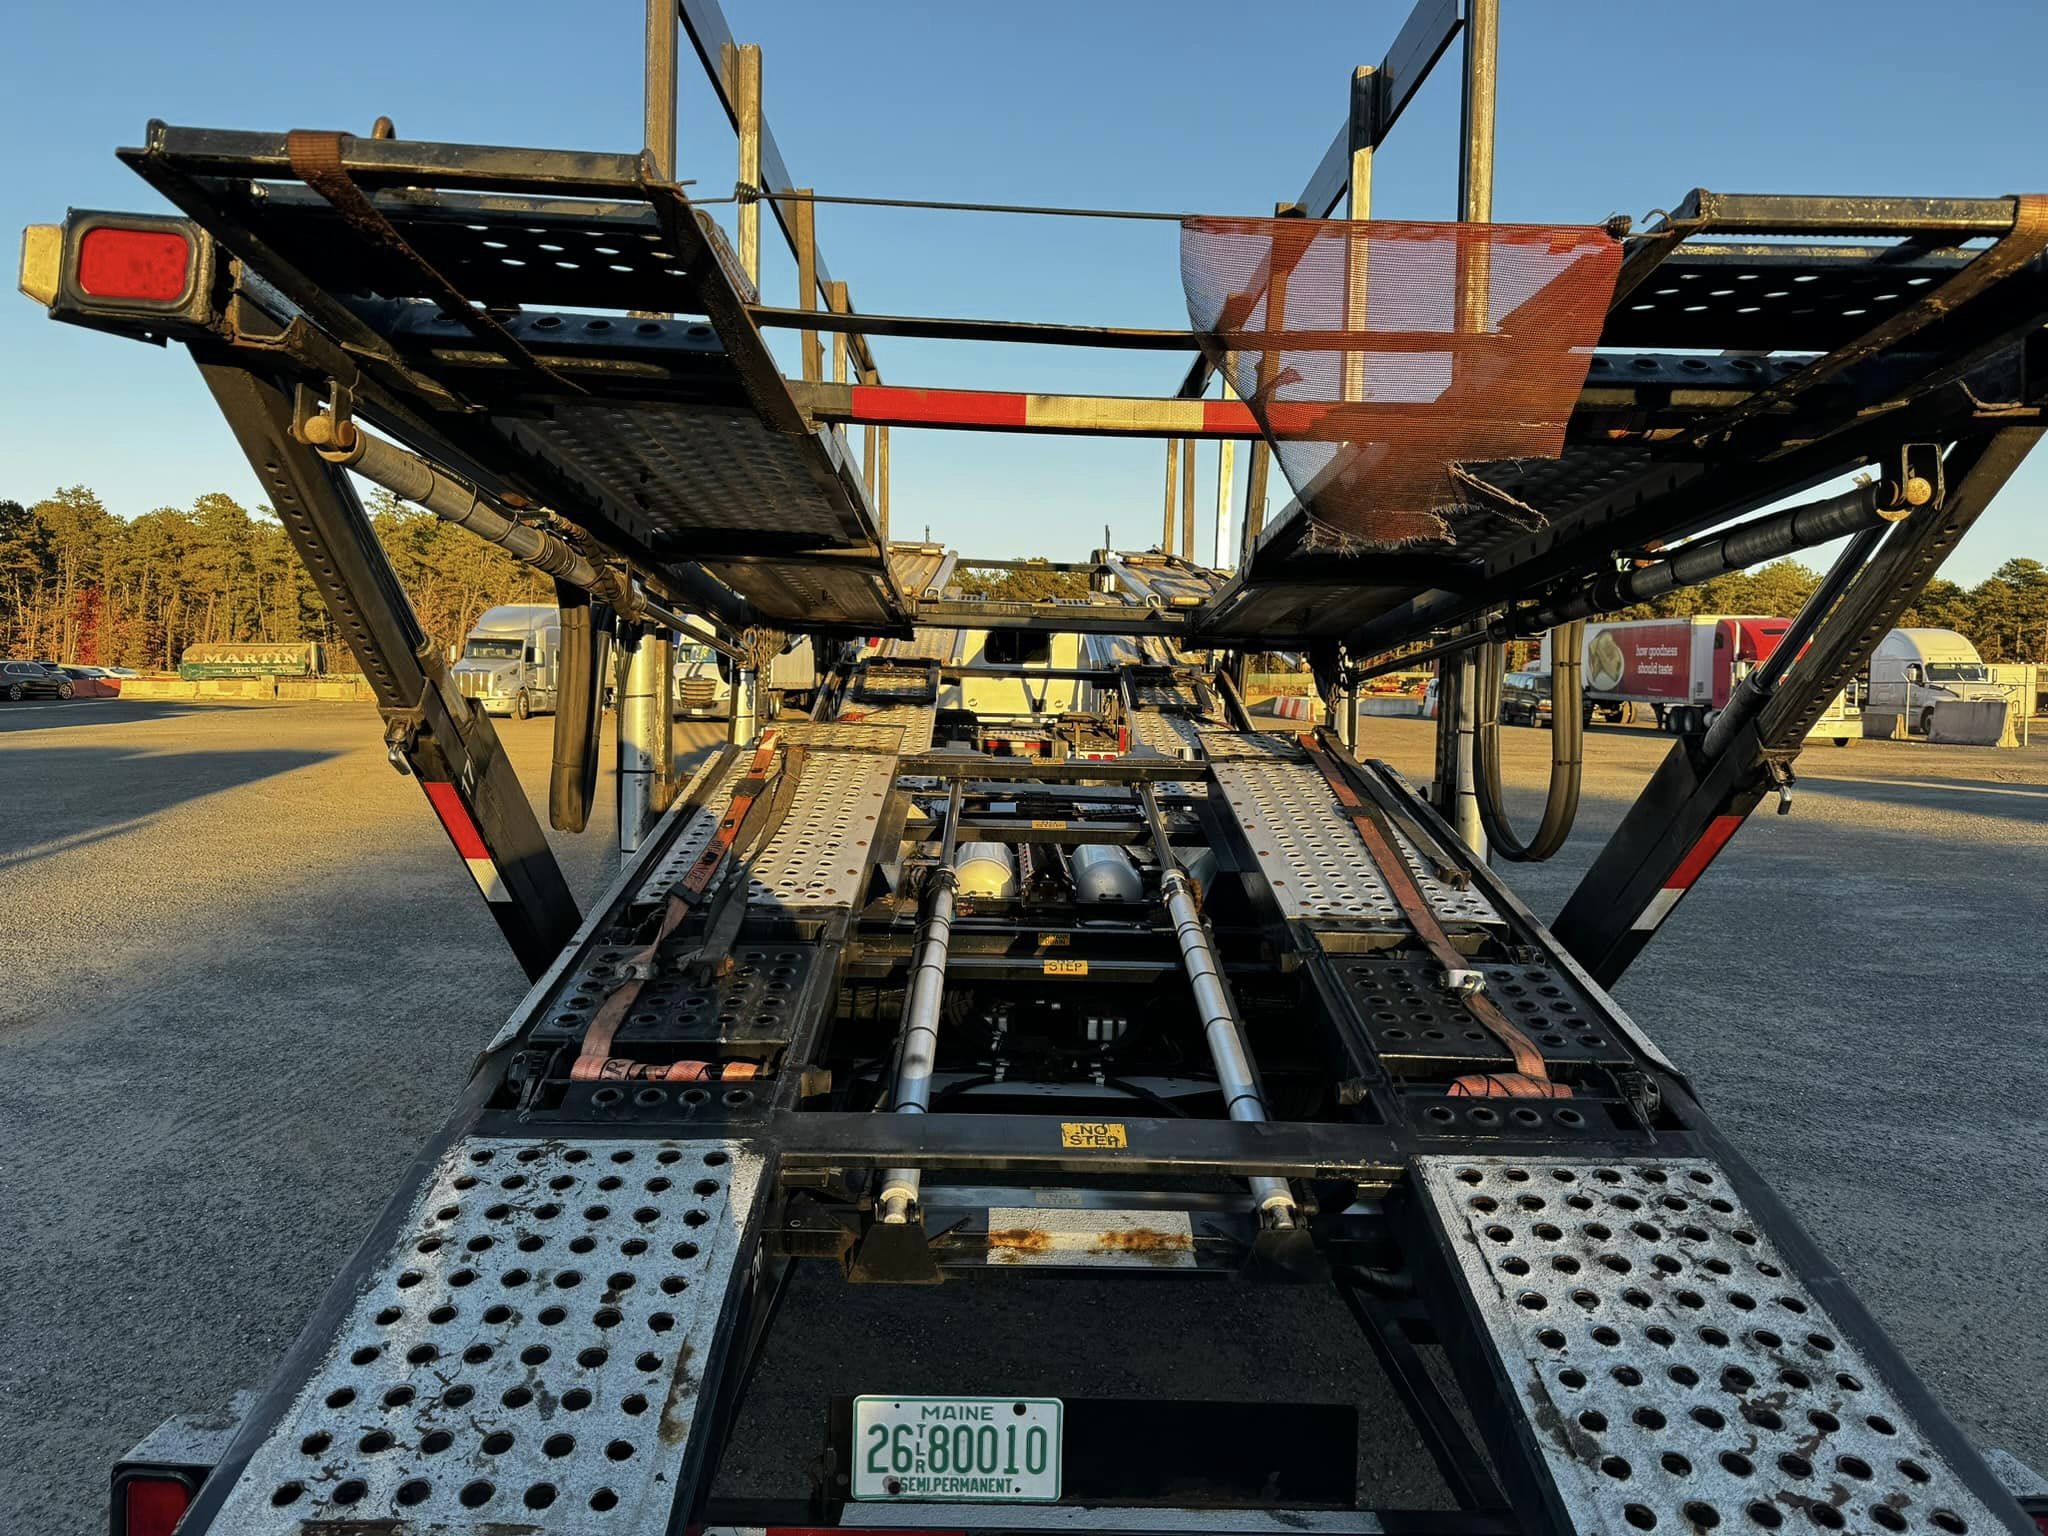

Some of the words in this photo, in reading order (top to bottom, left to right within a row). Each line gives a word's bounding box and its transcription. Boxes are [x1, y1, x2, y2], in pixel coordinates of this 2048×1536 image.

[1635, 643, 1649, 656] how
[1648, 643, 1678, 660] goodness
[202, 653, 298, 664] MARTIN
[1638, 662, 1658, 674] should
[1658, 664, 1673, 675] taste
[1048, 961, 1082, 972] STEP
[1080, 1124, 1108, 1135] NO
[1069, 1134, 1121, 1146] STEP
[921, 1406, 994, 1421] MAINE
